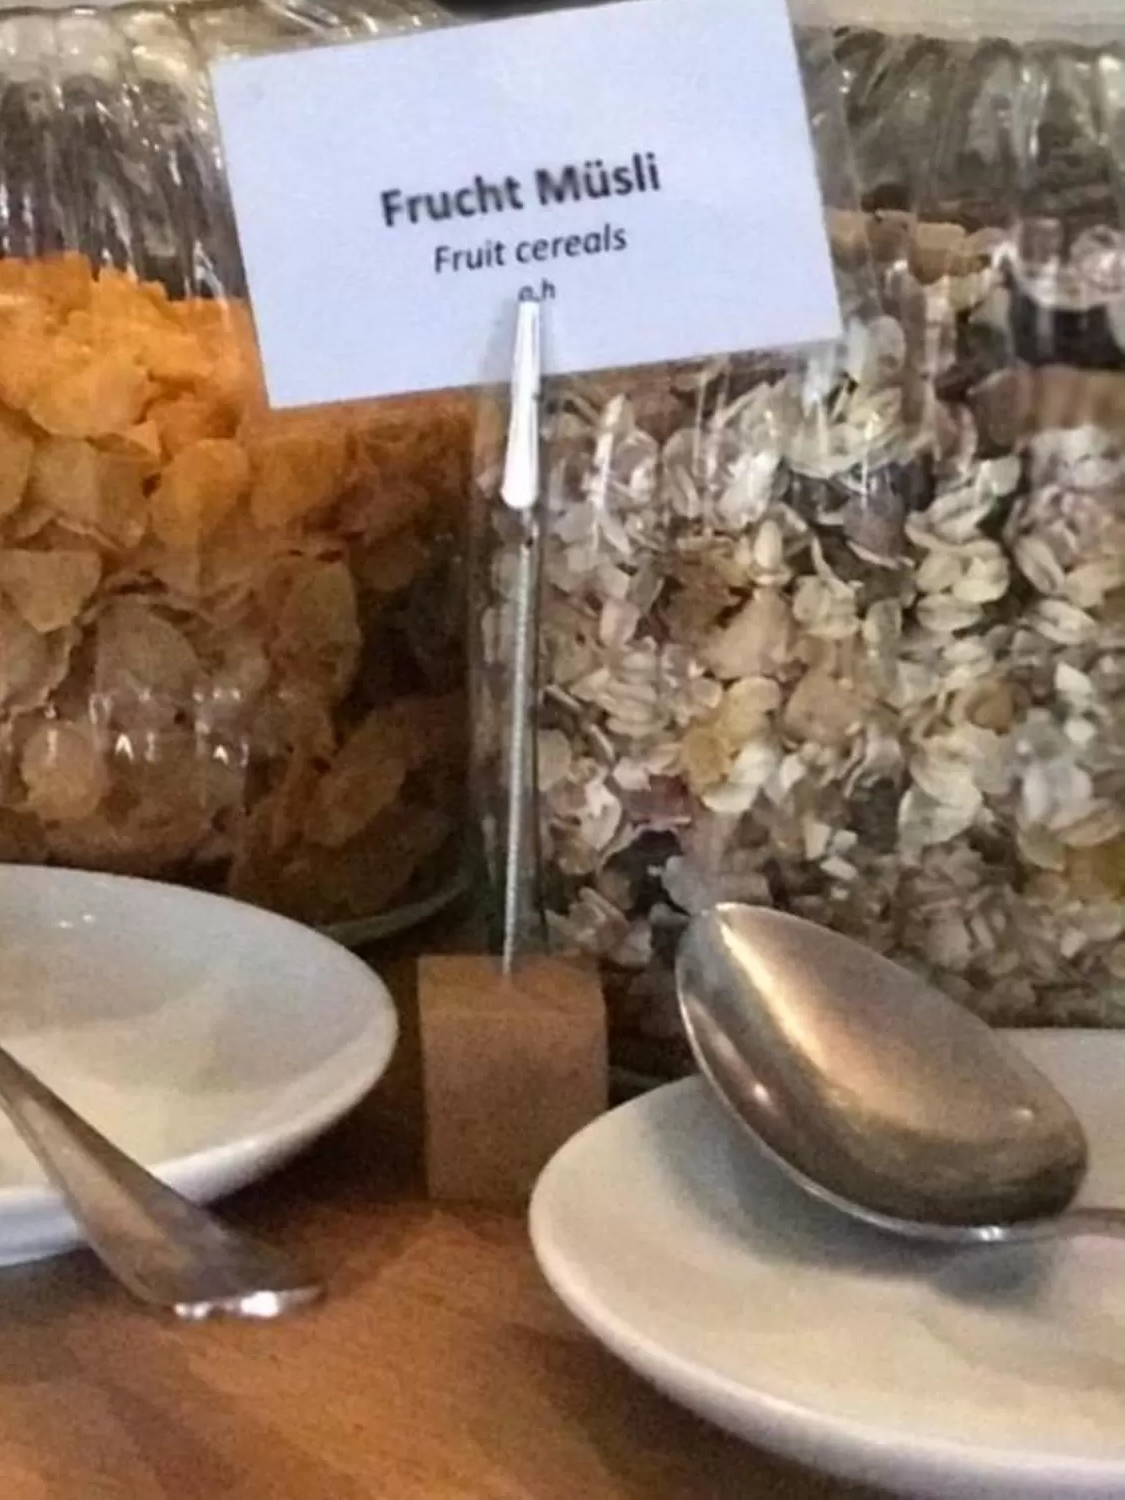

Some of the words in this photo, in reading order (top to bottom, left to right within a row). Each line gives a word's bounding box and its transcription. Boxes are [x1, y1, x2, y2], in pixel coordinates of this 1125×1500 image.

[380, 174, 524, 227] Frucht
[535, 151, 661, 206] Müsli
[434, 240, 506, 274] Fruit
[515, 222, 628, 264] cereals
